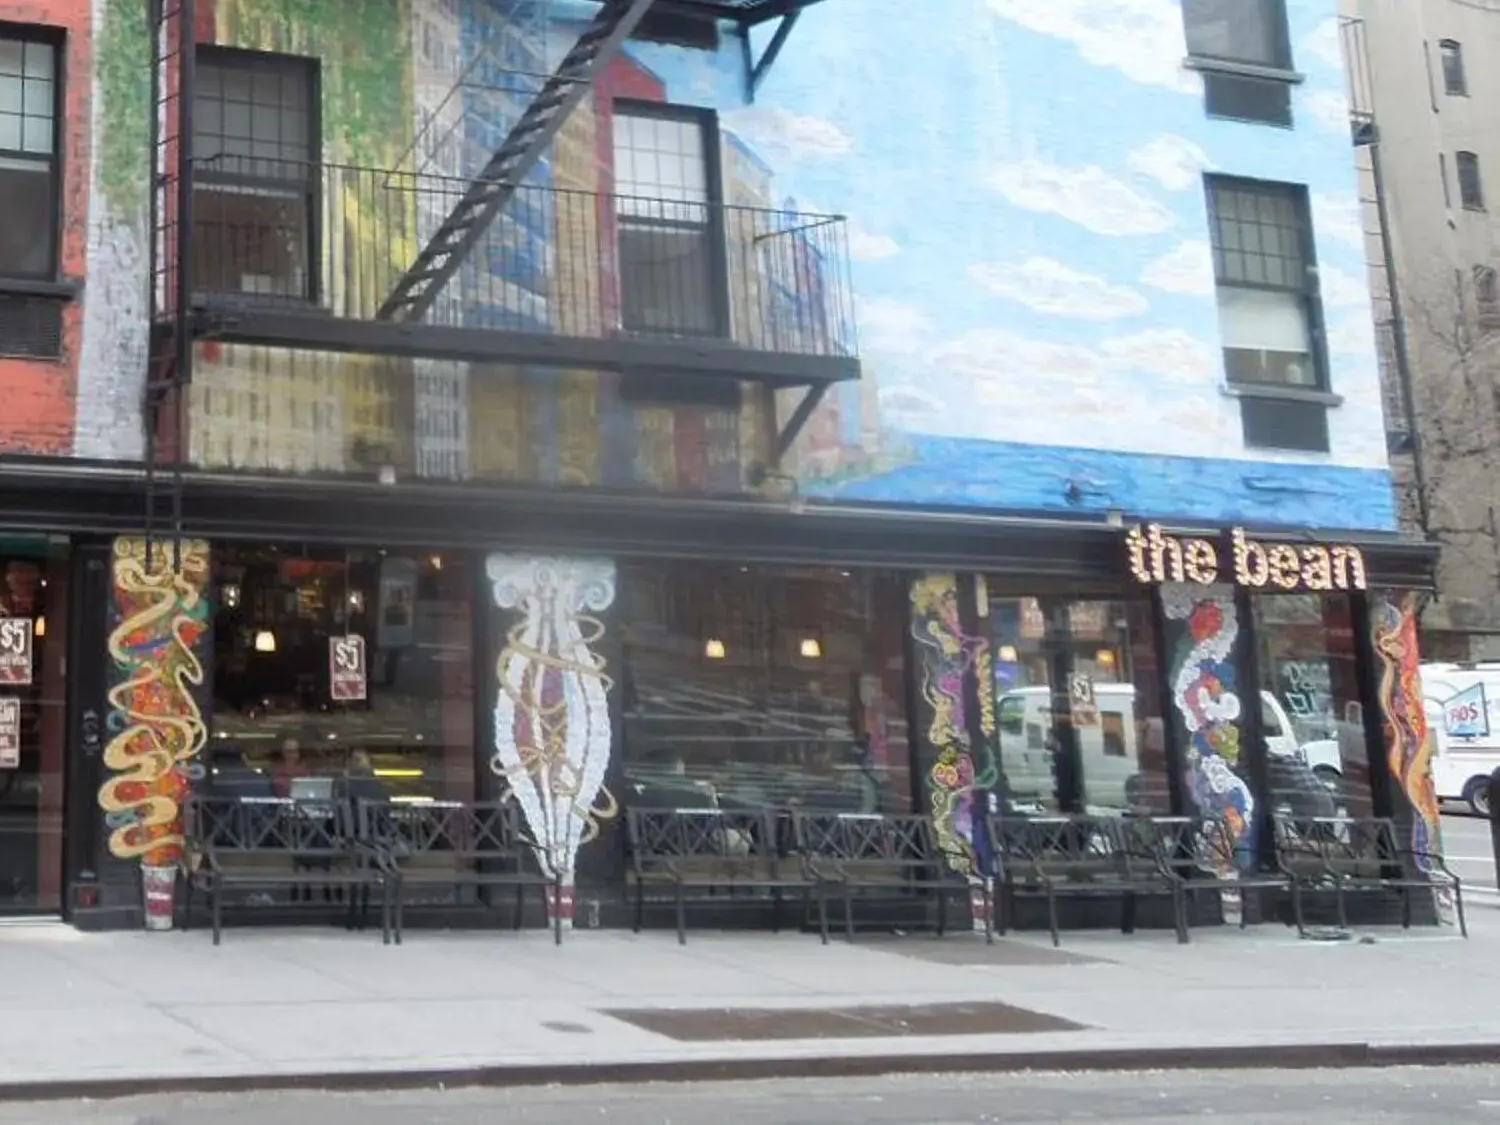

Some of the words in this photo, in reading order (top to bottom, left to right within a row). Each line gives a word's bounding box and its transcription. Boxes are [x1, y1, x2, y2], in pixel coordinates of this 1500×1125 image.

[1125, 523, 1219, 585] the
[1231, 526, 1367, 590] bean
[0, 619, 25, 654] $5
[335, 640, 359, 670] $5
